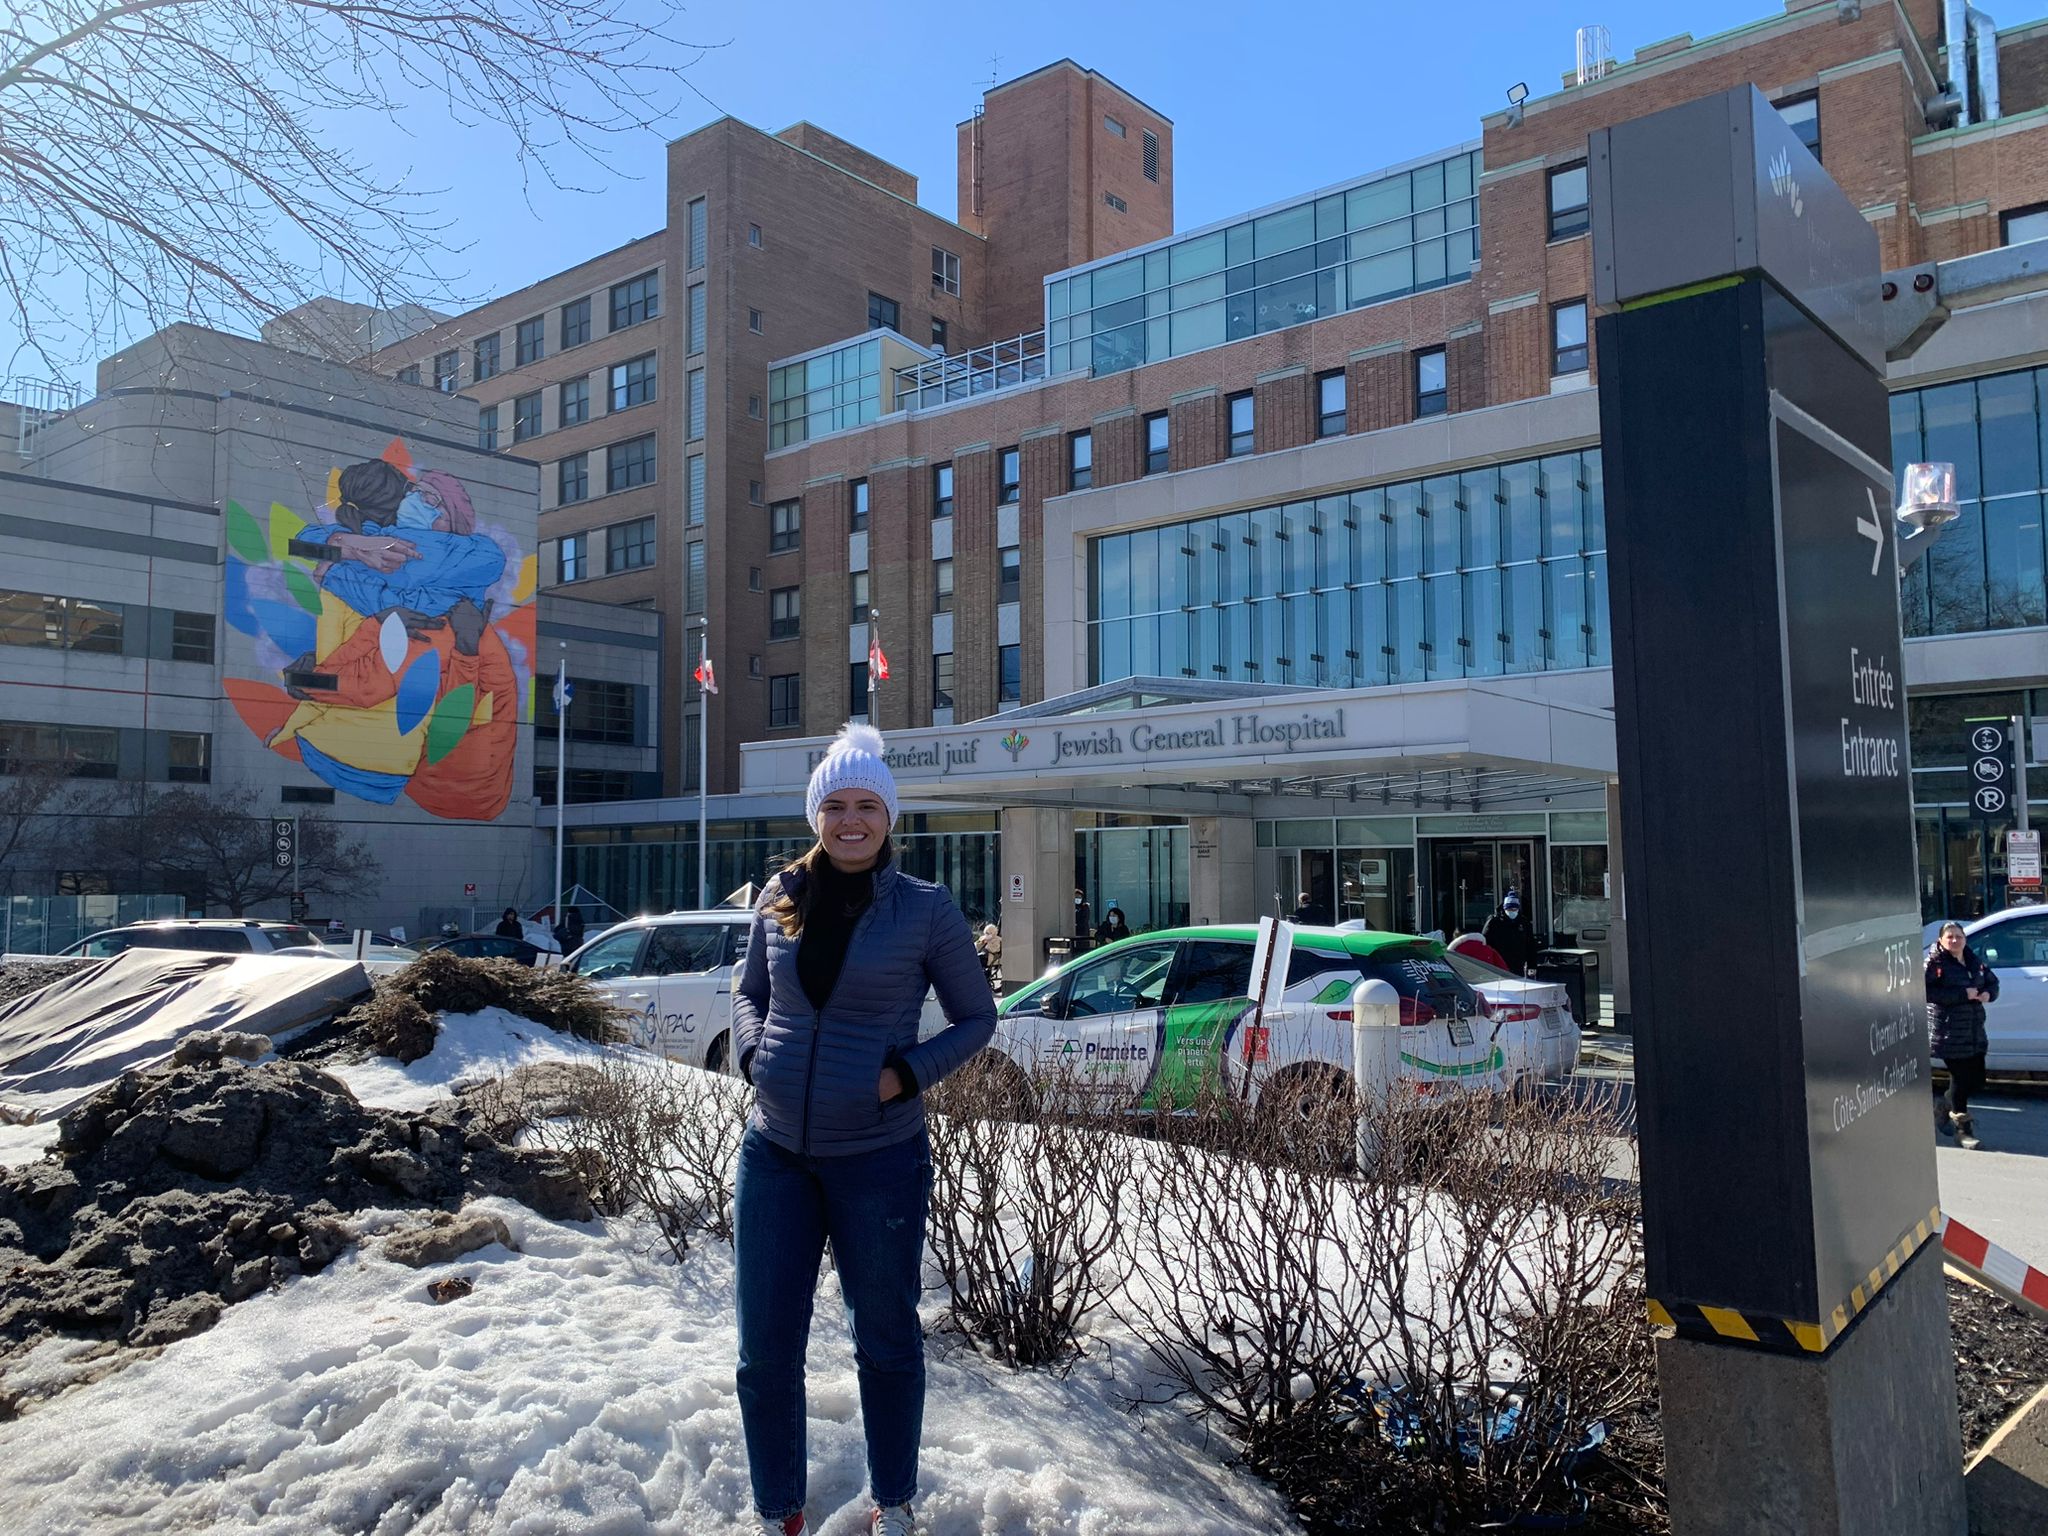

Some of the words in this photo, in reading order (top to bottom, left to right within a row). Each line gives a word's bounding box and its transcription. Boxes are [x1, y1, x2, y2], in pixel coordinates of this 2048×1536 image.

[1850, 647, 1895, 710] Entrée
[943, 738, 980, 774] juif
[1050, 727, 1123, 764] Jewish
[1130, 718, 1224, 753] General
[1232, 708, 1346, 751] Hospital
[1841, 717, 1899, 777] Entrance
[1884, 939, 1912, 993] 3755
[1176, 1036, 1194, 1045] Vers
[1869, 1017, 1898, 1056] Chemin
[1898, 1005, 1908, 1041] de
[1907, 1001, 1915, 1034] la
[1833, 1054, 1918, 1132] Côte-Sainte-Catherine
